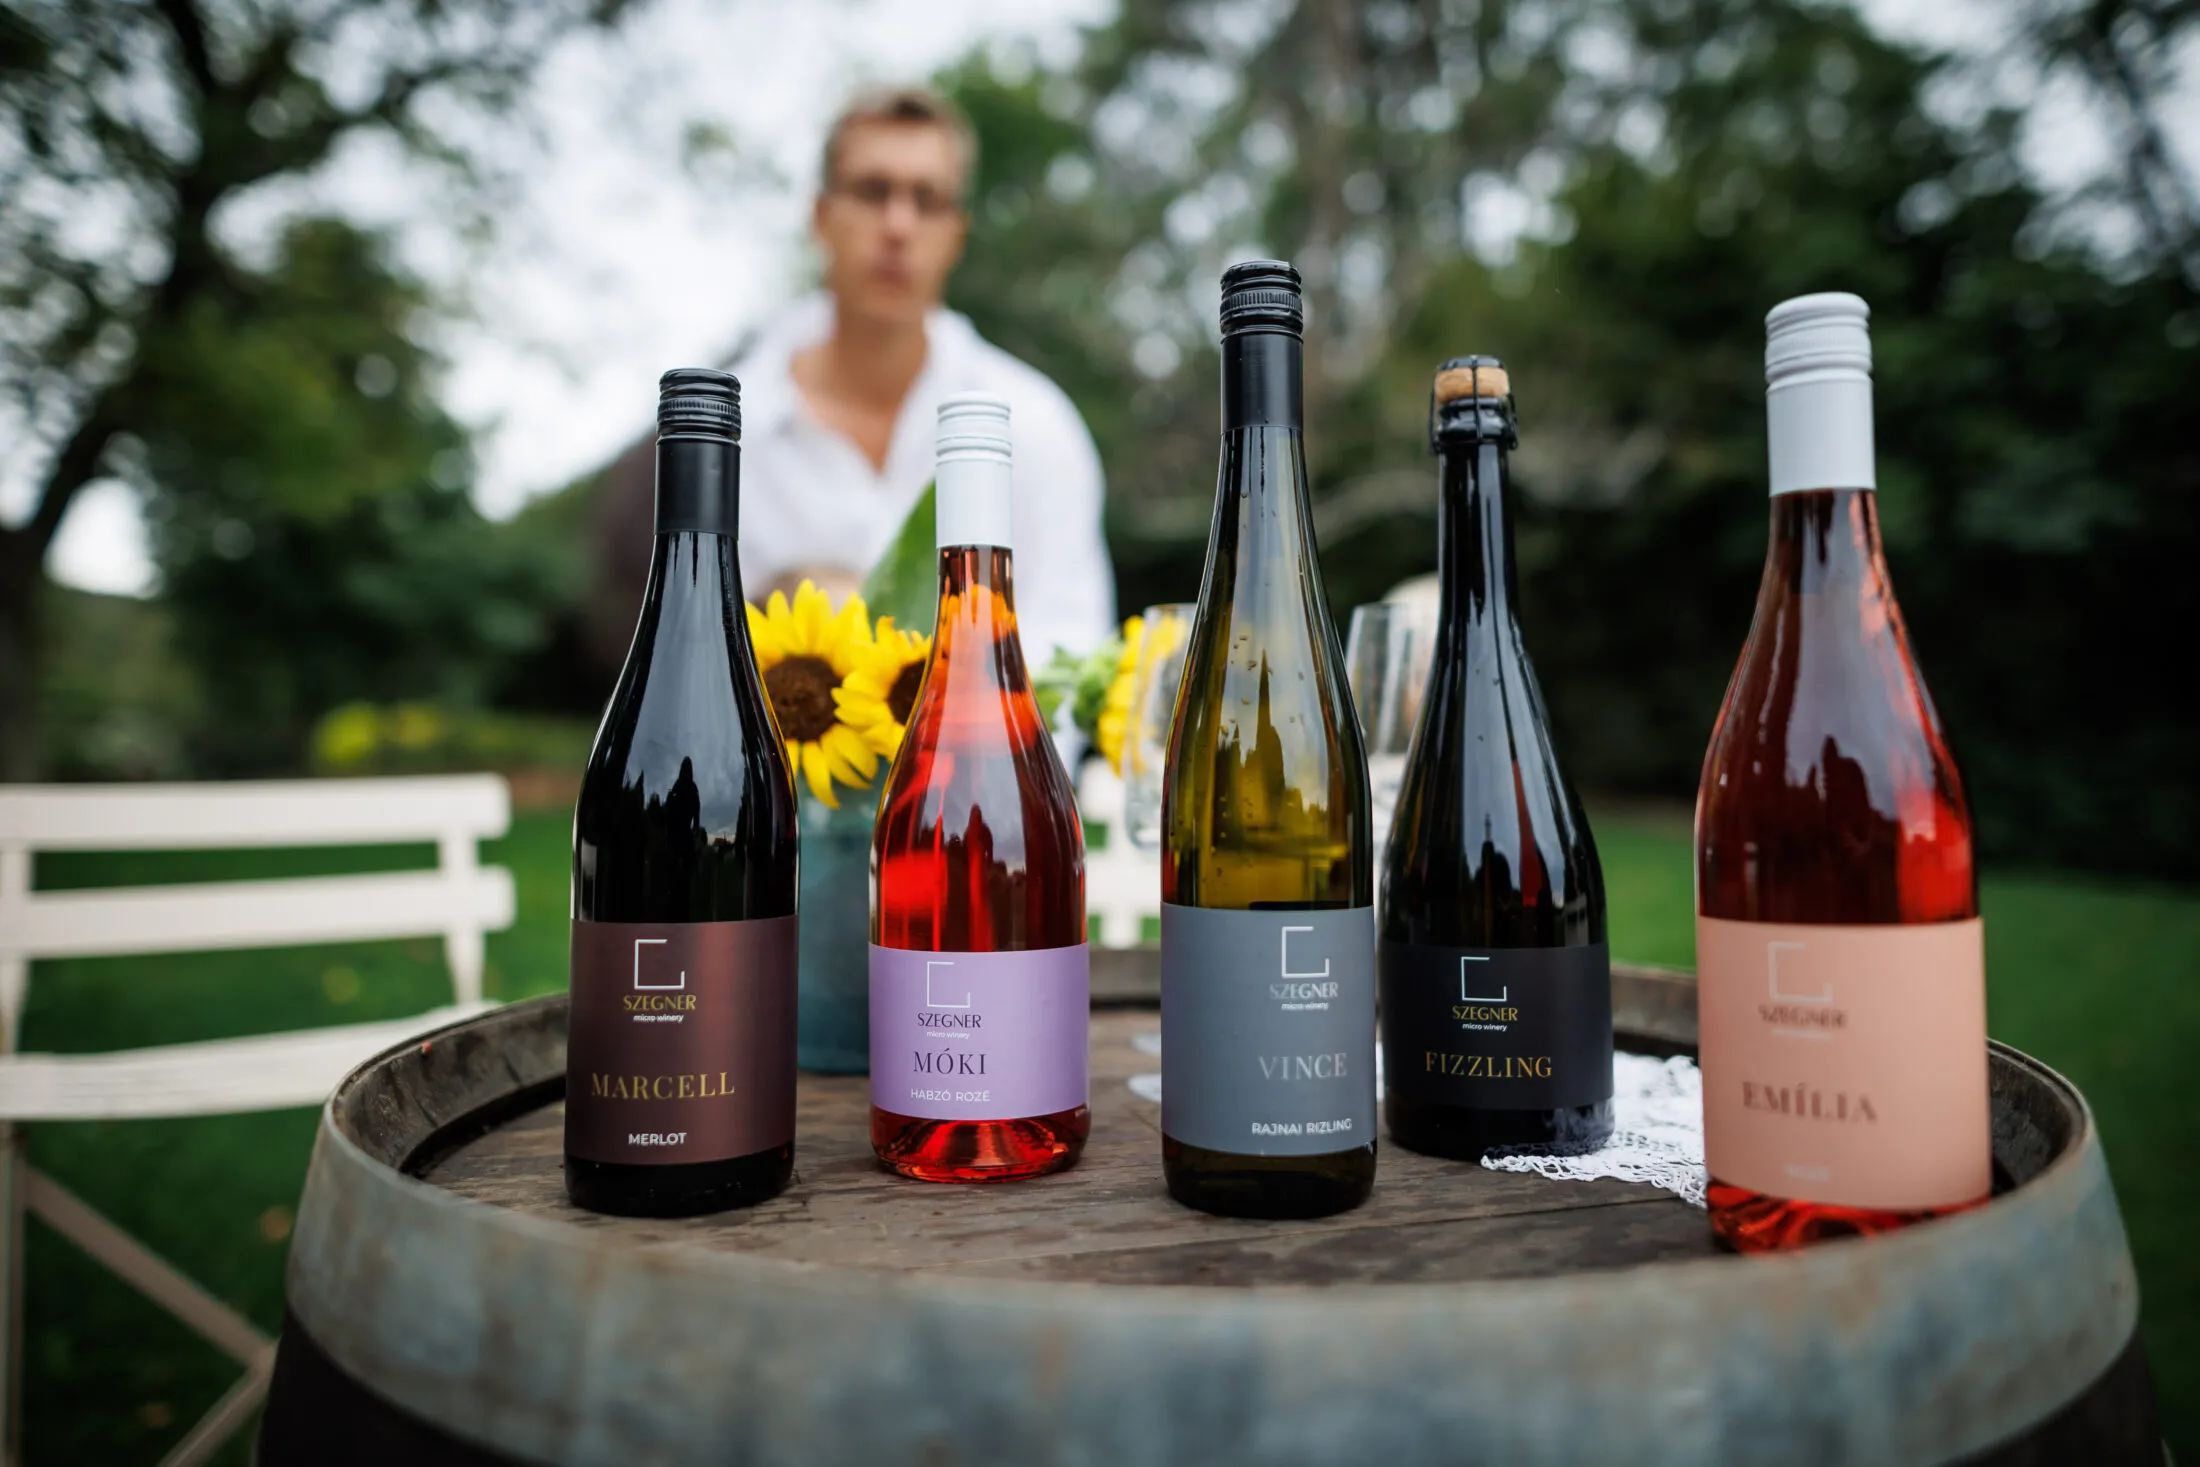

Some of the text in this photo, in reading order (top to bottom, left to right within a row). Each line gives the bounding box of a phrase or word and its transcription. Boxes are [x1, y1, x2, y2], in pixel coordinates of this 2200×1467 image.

[1269, 982, 1338, 999] SZEGNER
[623, 994, 697, 1011] SZEGNER
[633, 1013, 684, 1023] micro winery
[917, 1012, 982, 1029] SZEGNER
[1452, 1005, 1519, 1021] SZEGNER
[926, 1030, 970, 1040] micro winery
[1462, 1023, 1508, 1032] micro winery
[913, 1048, 987, 1075] MÓKI
[1258, 1053, 1348, 1081] VINCE
[1425, 1052, 1553, 1079] FIZZLING
[592, 1072, 736, 1100] MARCELL
[911, 1088, 991, 1101] HABZÓ ROZÉ
[1742, 1081, 1879, 1124] EMÍLIA
[1251, 1118, 1353, 1136] RAJNAI RIZLING
[628, 1132, 687, 1146] MERLOT
